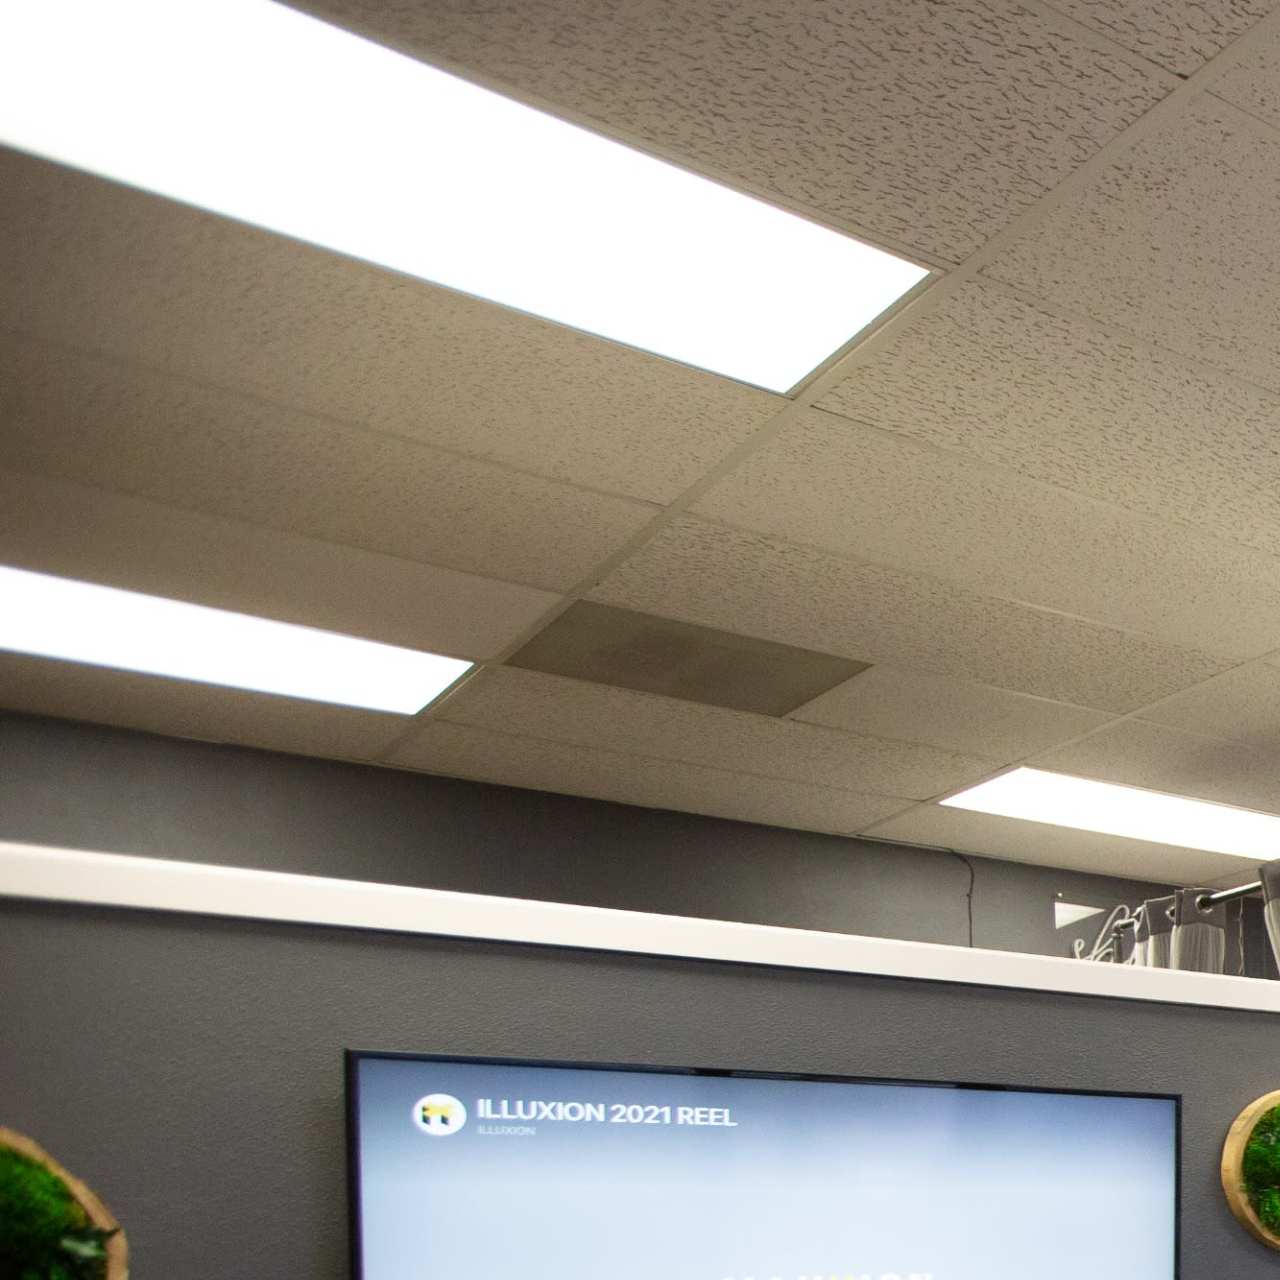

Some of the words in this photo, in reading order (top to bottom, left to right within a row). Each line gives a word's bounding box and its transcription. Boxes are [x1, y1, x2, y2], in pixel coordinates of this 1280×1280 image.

[477, 1098, 604, 1122] ILLUXION
[610, 1103, 670, 1125] 2021
[677, 1106, 738, 1127] REEL
[477, 1125, 536, 1136] ILLUXION
